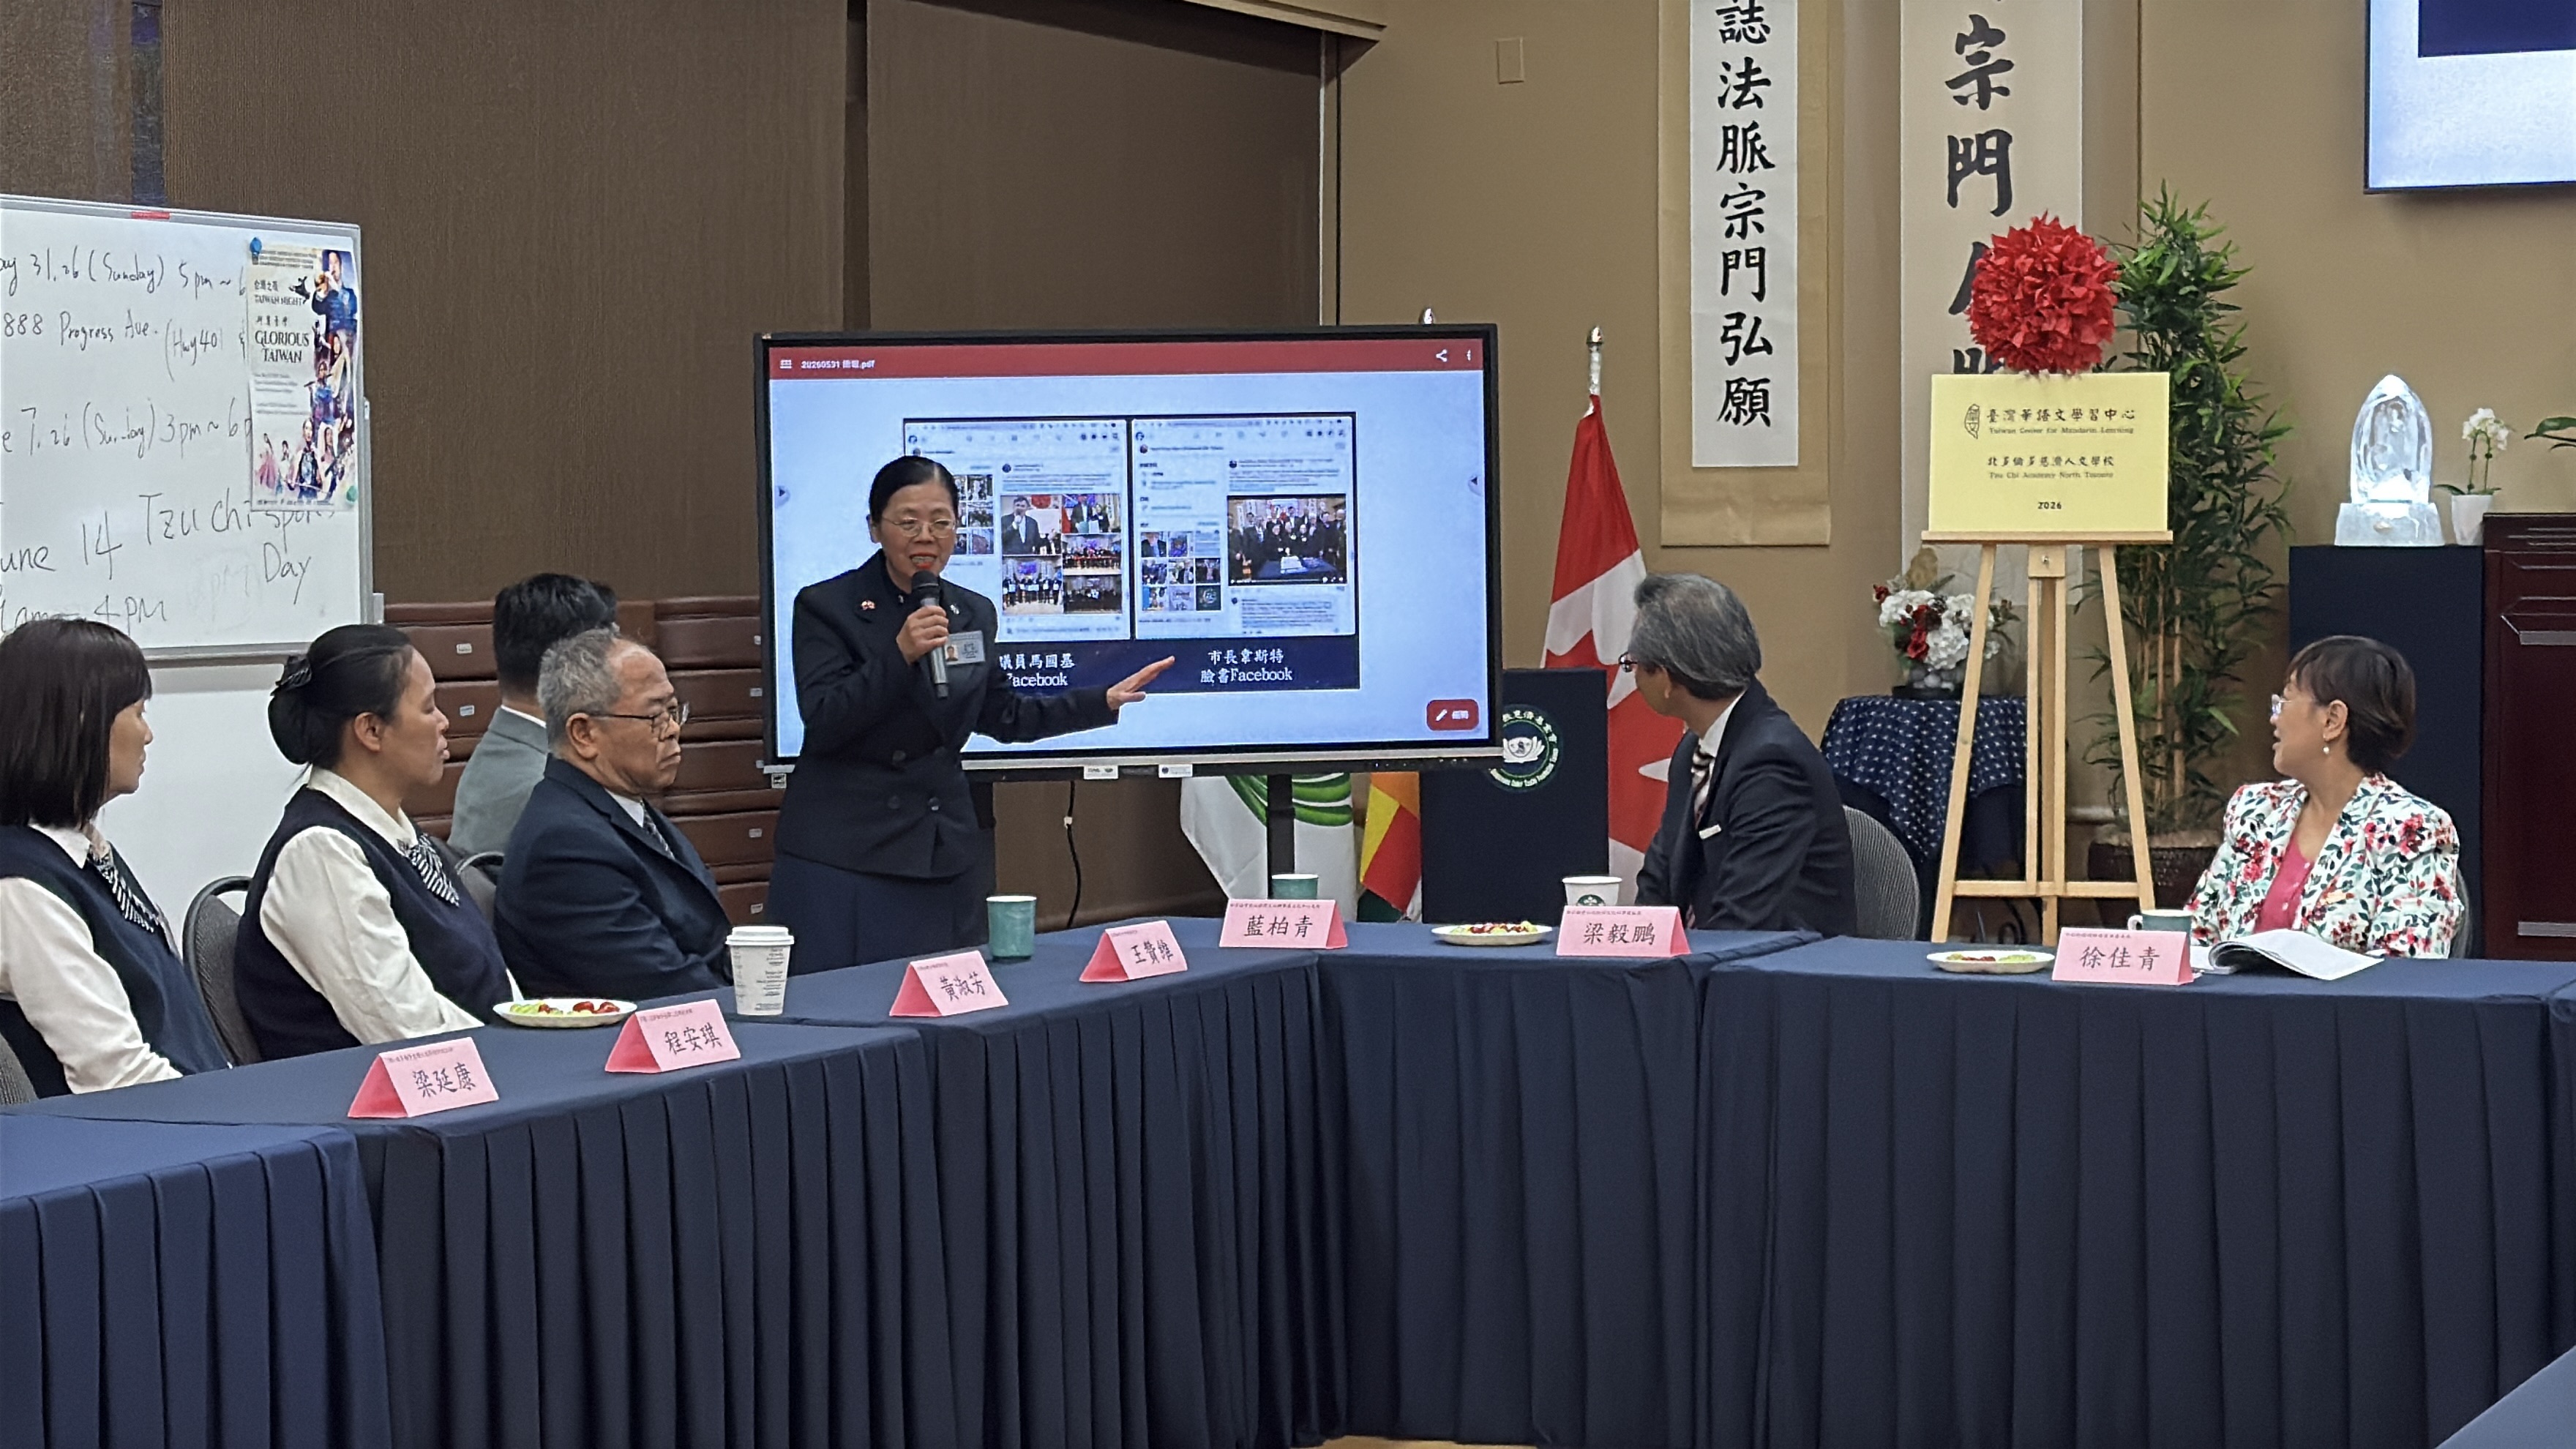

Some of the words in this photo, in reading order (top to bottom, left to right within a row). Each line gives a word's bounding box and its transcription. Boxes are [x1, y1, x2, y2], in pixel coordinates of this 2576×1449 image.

[1945, 14, 2015, 374] 宗門
[59, 310, 114, 351] Progress
[255, 331, 310, 347] GLORIOUS
[262, 348, 302, 363] TAIWAN
[2037, 501, 2062, 510] 2026
[0, 545, 56, 573] une
[263, 542, 311, 604] Day
[1243, 915, 1313, 938] 藍柏青
[1583, 922, 1656, 946] 梁毅鵬
[2079, 946, 2160, 971] 徐佳青
